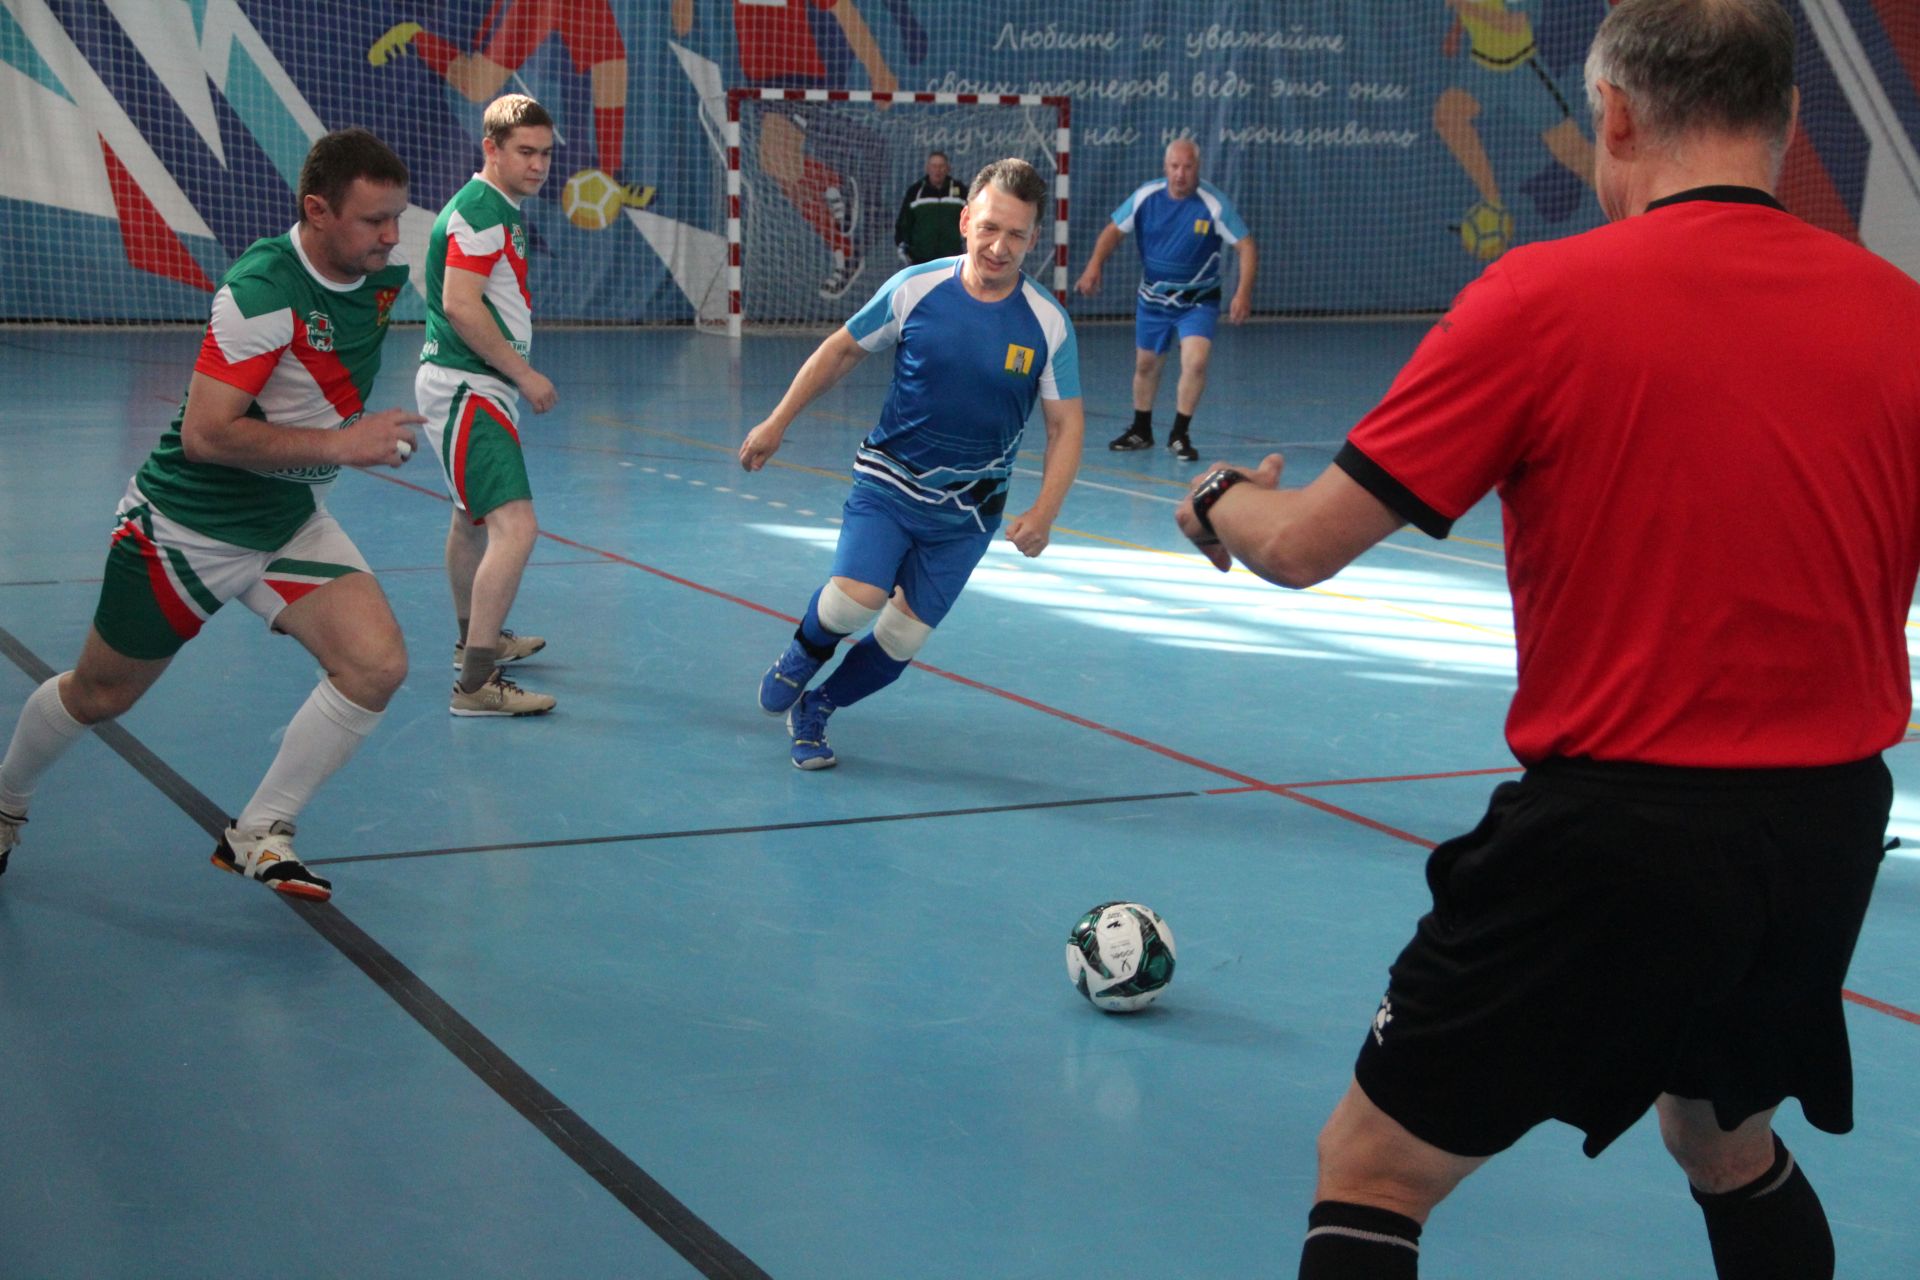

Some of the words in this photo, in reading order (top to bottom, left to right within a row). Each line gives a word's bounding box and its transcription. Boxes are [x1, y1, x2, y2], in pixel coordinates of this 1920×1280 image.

[994, 23, 1120, 50] Любите
[1142, 34, 1165, 50] и
[1187, 24, 1345, 57] уважайте
[1191, 70, 1254, 98] ведь
[1270, 78, 1331, 98] это
[1349, 80, 1410, 99] они
[1084, 126, 1141, 146] нас
[1218, 120, 1419, 149] проигрывать
